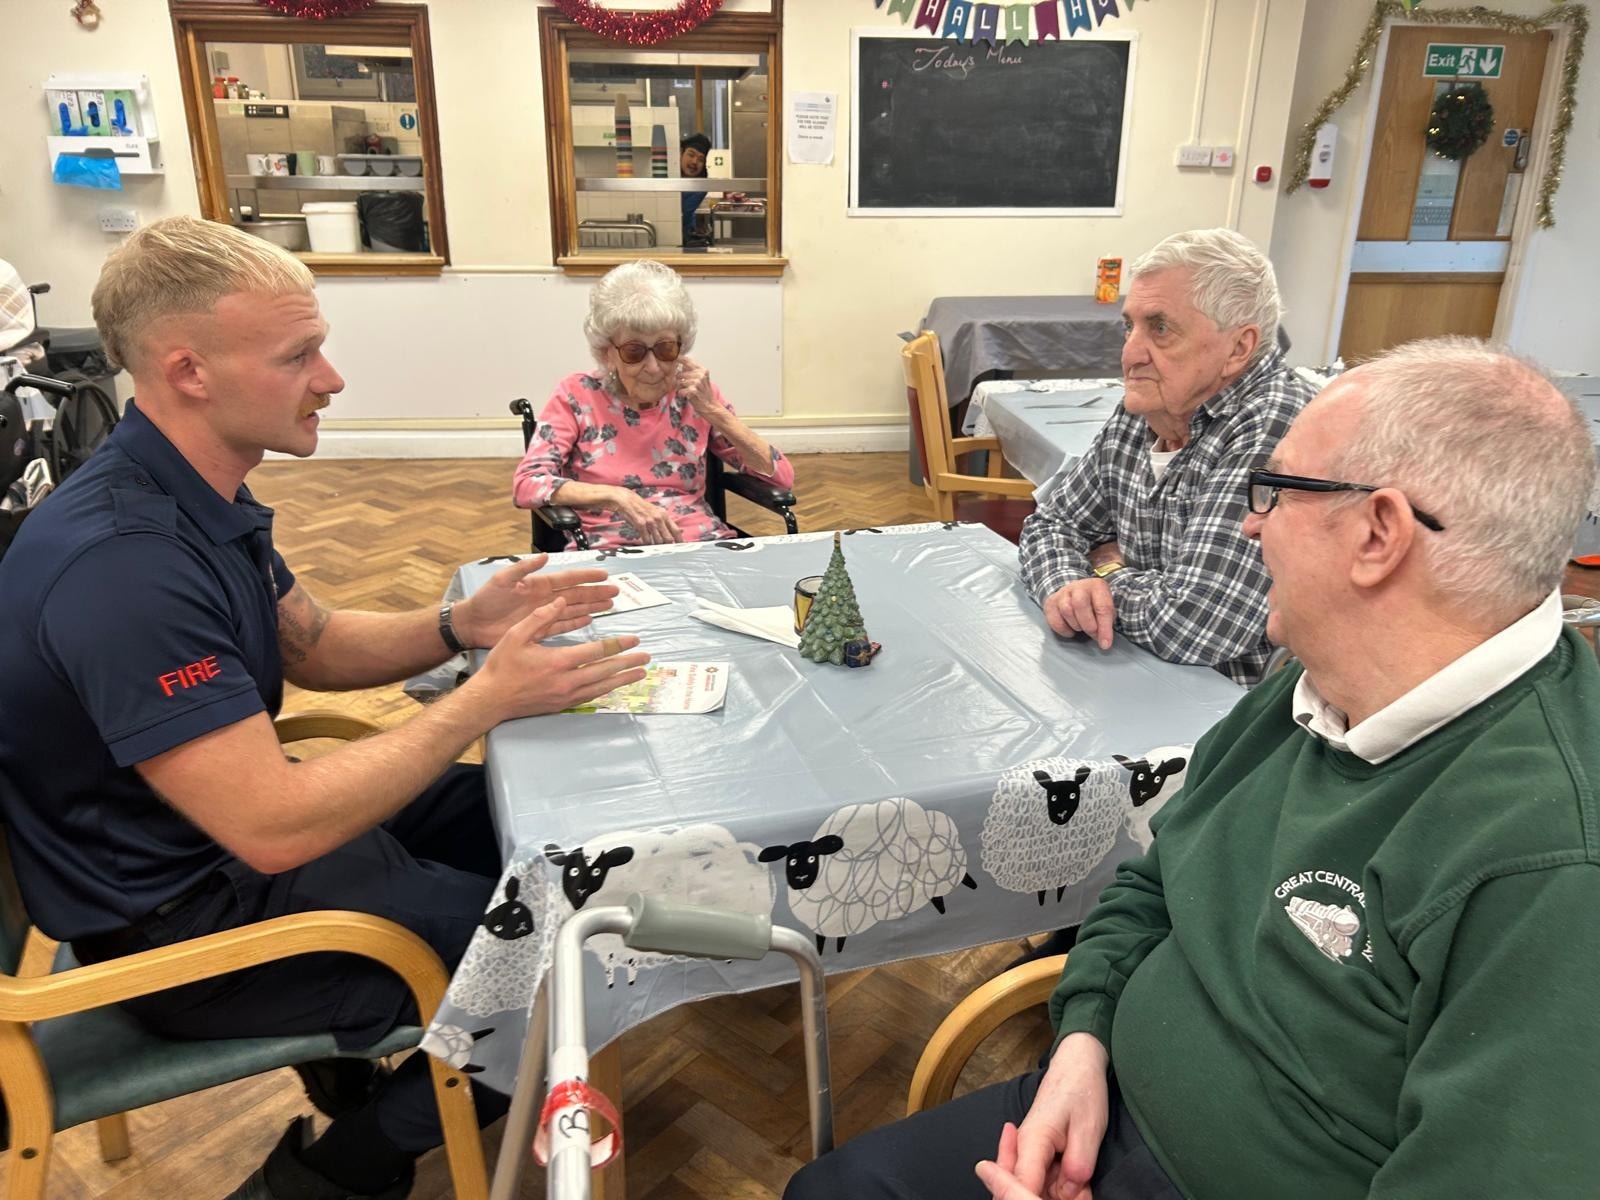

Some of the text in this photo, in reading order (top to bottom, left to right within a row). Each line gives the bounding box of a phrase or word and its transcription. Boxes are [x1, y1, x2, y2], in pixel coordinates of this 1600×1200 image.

[899, 0, 1022, 30] HALL
[912, 45, 1022, 79] Today's Menu
[1428, 53, 1456, 67] Exit
[158, 655, 222, 697] FIRE
[1274, 871, 1313, 899] GREAT
